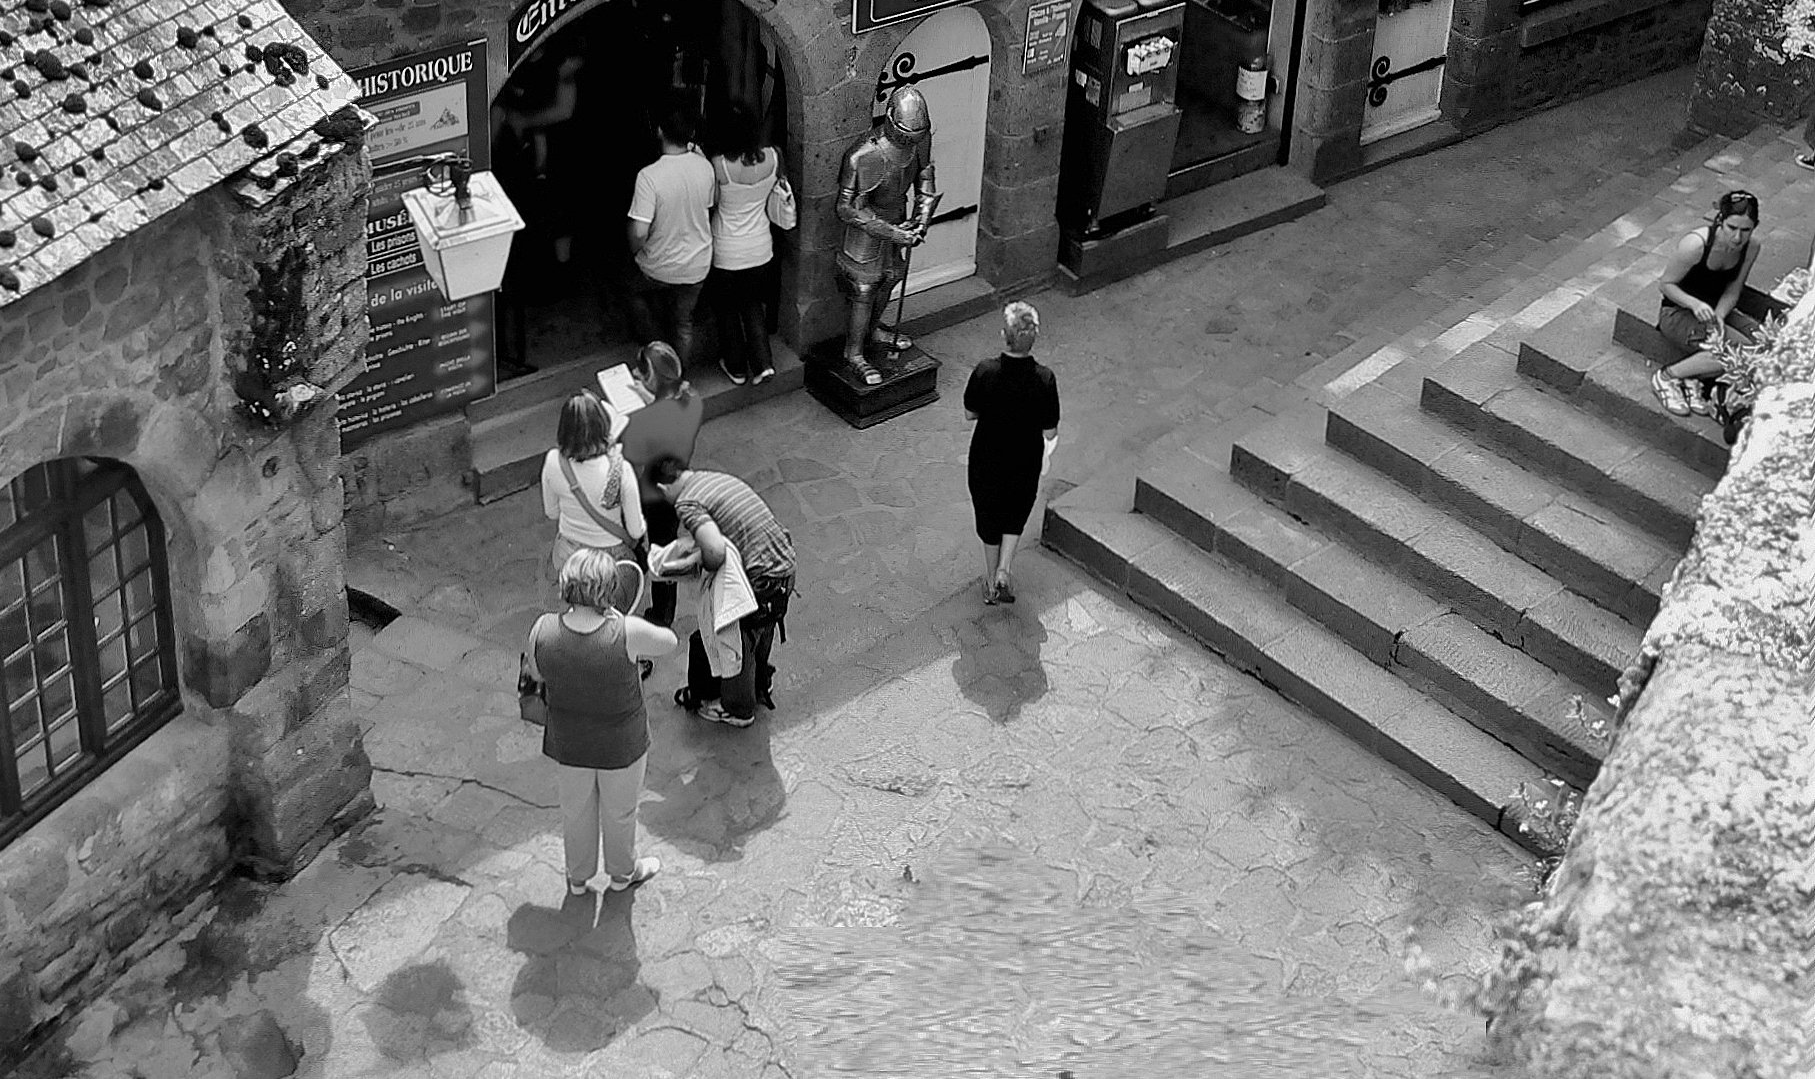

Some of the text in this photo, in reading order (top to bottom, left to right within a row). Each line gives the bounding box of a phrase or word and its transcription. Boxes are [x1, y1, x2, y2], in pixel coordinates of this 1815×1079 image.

[357, 51, 473, 98] HISTORIQUE
[371, 231, 416, 253] Les prisons
[370, 252, 417, 275] Les cachots
[370, 292, 387, 307] de
[390, 288, 403, 302] la
